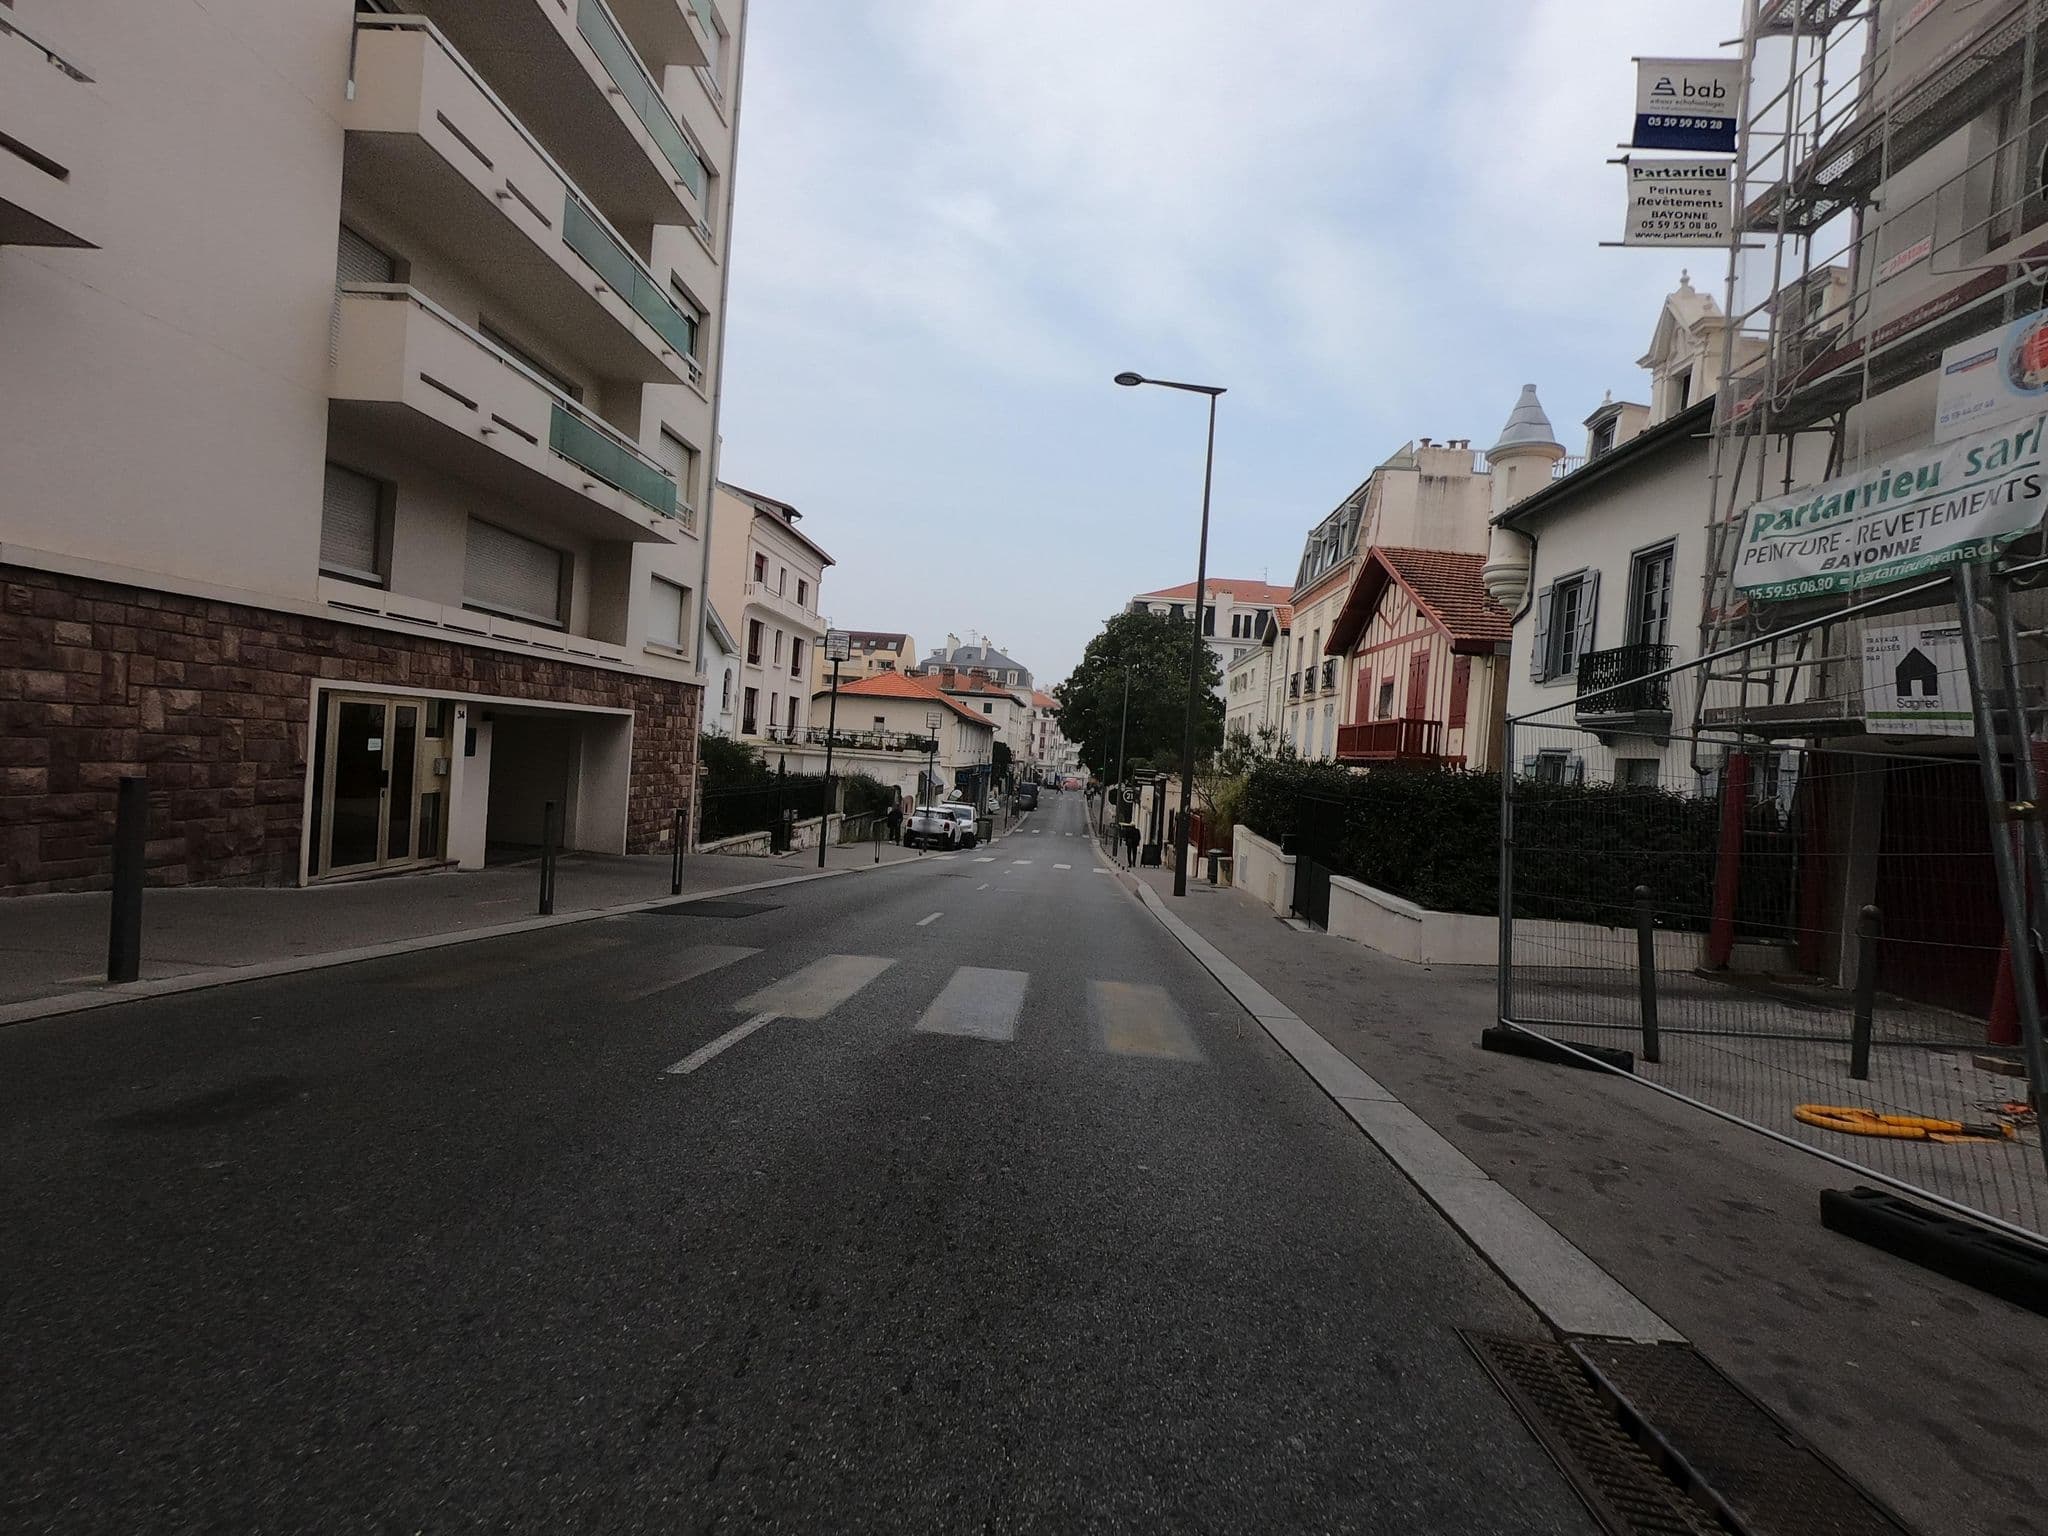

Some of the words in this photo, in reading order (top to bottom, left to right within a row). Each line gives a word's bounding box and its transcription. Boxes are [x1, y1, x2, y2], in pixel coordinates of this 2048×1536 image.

[1683, 77, 1726, 98] bab
[1647, 116, 1661, 127] 05
[1663, 118, 1677, 127] 59
[1679, 118, 1692, 128] 59
[1709, 120, 1722, 130] 28
[1633, 165, 1726, 178] Partarrieu
[1649, 185, 1712, 196] Peintures
[1651, 210, 1708, 220] BAYONNE
[1641, 220, 1654, 229] 05
[1658, 221, 1670, 229] 59
[1673, 221, 1685, 229] 55
[1963, 415, 2047, 478] sarl
[1744, 532, 1842, 566] PEINTURE
[1857, 474, 2042, 546] REVETEMENTS
[1819, 535, 1922, 571] BAYONNE
